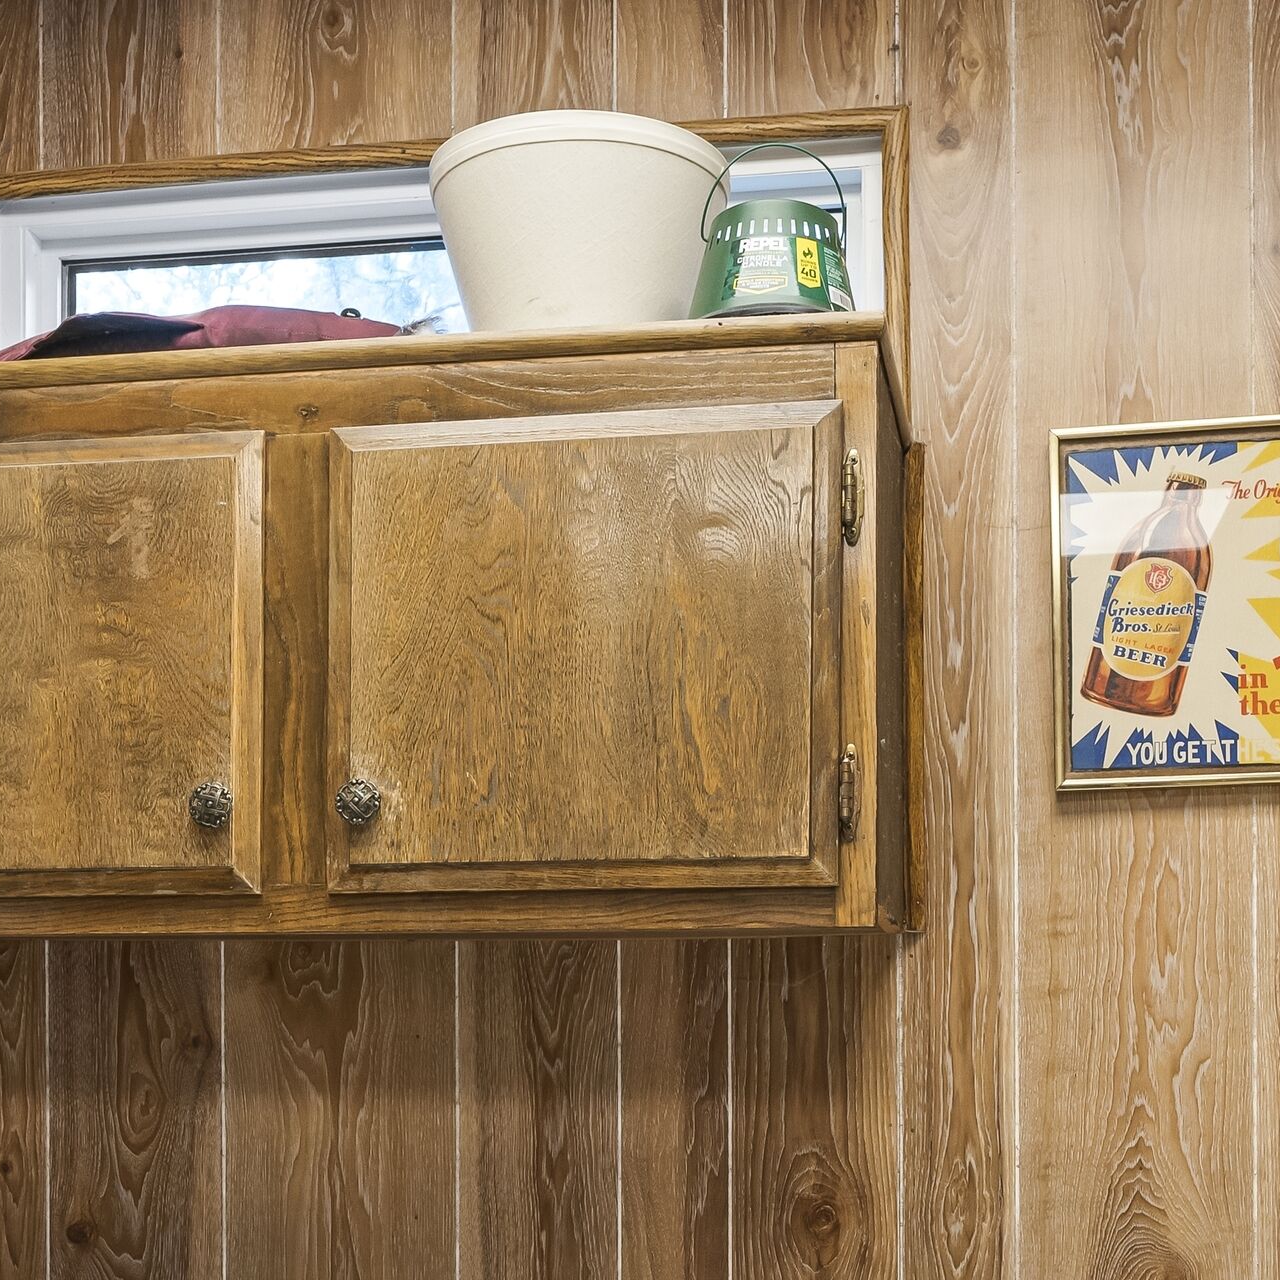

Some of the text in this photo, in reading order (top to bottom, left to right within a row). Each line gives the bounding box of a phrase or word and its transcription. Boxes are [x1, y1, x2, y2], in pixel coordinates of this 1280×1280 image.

[739, 237, 788, 254] REPEL
[737, 254, 788, 264] CITRONELLA
[801, 267, 817, 279] 40
[1221, 480, 1251, 500] The
[1108, 599, 1194, 616] Griesedieck
[1111, 617, 1152, 634] Bros.
[1111, 635, 1176, 654] LIGHT LAGER
[1113, 645, 1167, 667] BEER
[1238, 664, 1268, 689] in
[1126, 739, 1168, 766] YOU
[1173, 740, 1217, 764] GET
[1219, 737, 1266, 763] THE
